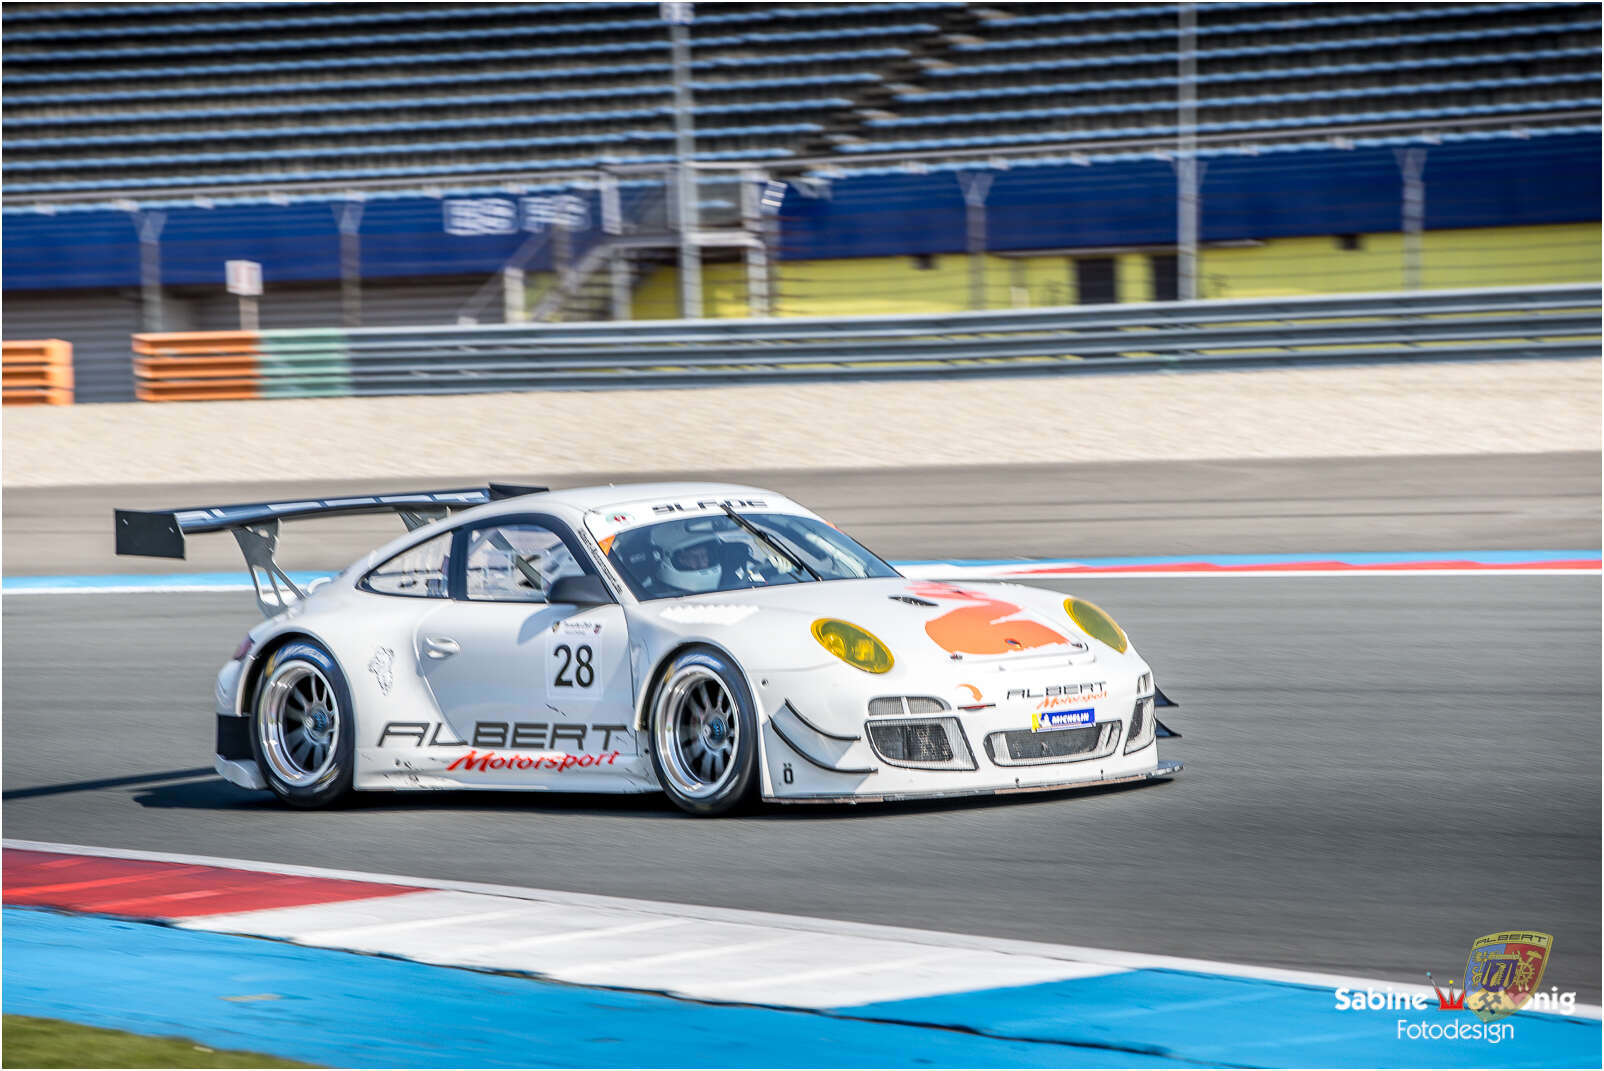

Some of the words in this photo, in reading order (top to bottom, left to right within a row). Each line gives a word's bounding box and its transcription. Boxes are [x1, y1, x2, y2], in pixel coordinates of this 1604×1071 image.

[553, 644, 595, 688] 28
[1006, 681, 1107, 700] ALBERT
[377, 721, 627, 750] ALBERT
[445, 750, 621, 773] Motorsport
